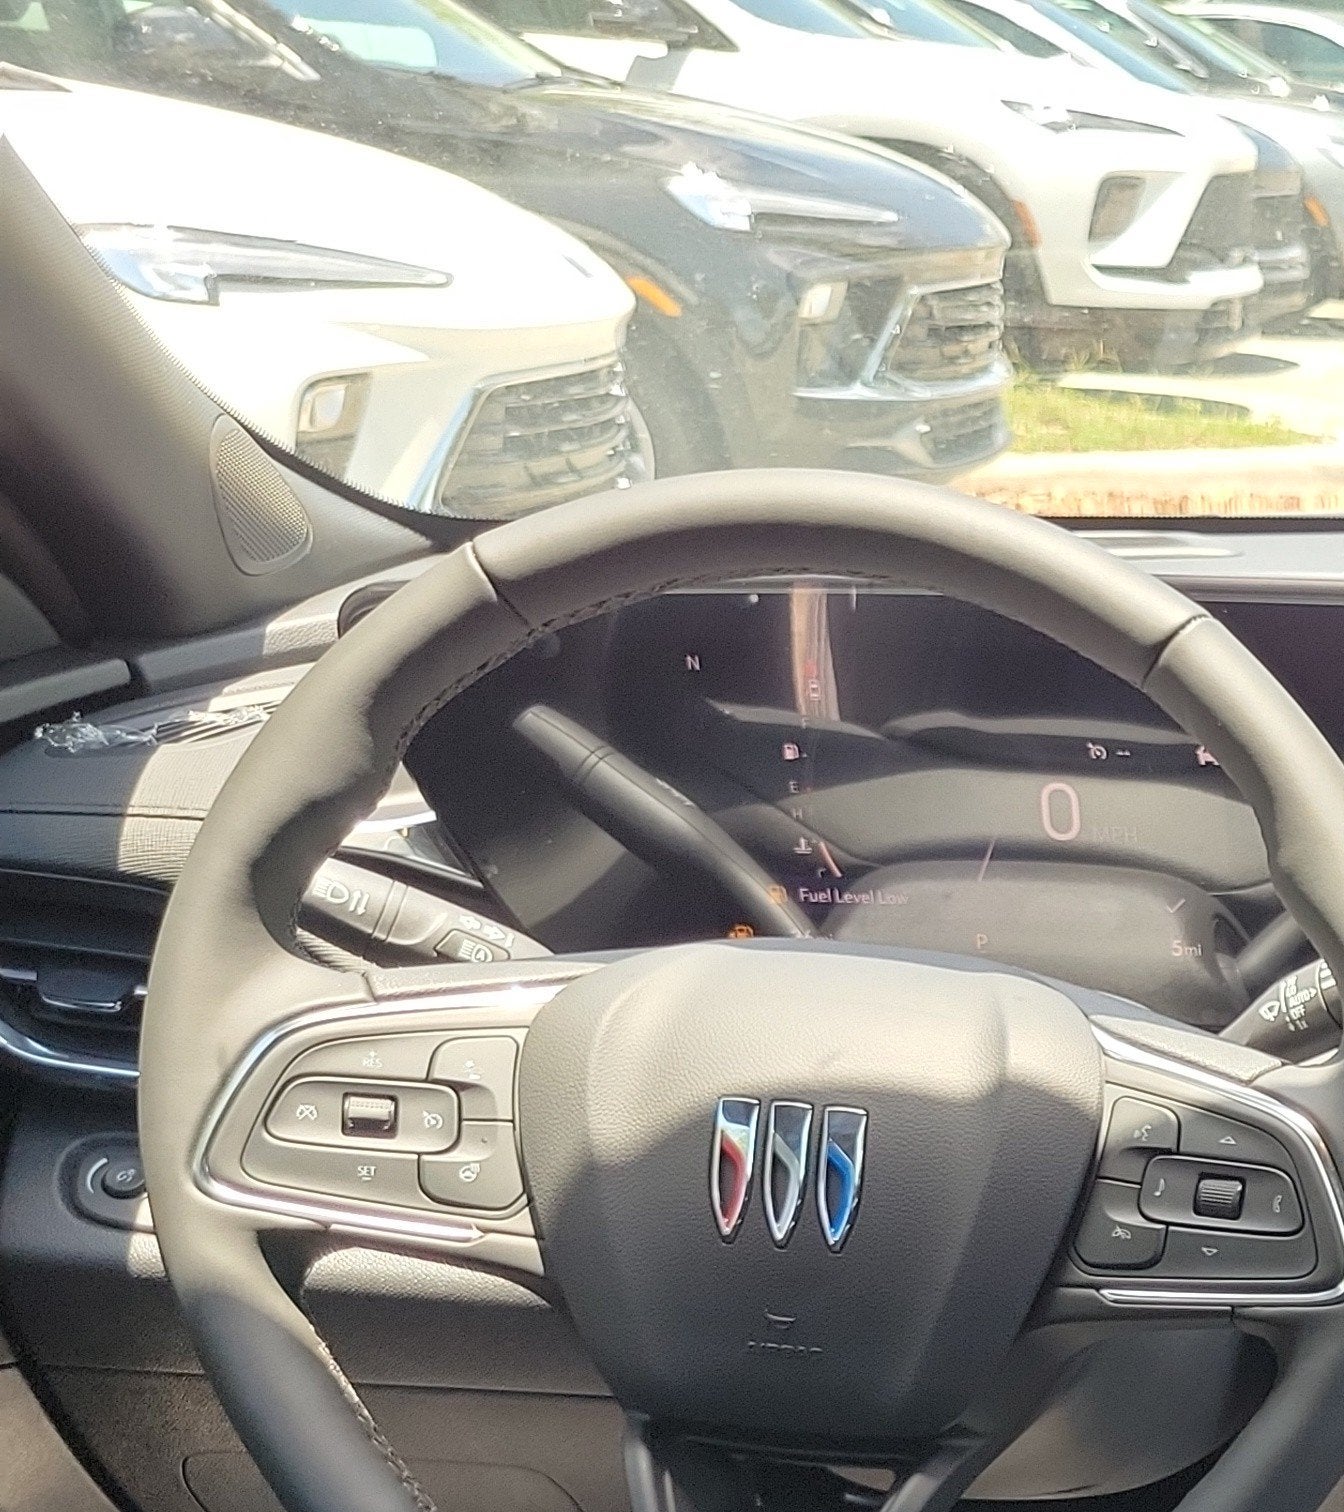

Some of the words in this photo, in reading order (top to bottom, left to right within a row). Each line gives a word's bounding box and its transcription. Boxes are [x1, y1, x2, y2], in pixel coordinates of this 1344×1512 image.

[686, 654, 700, 670] N
[1040, 782, 1081, 841] 0
[799, 887, 831, 903] Fuel
[835, 889, 873, 904] Level
[878, 890, 909, 905] Low
[976, 933, 989, 950] P
[357, 1165, 377, 1178] SET
